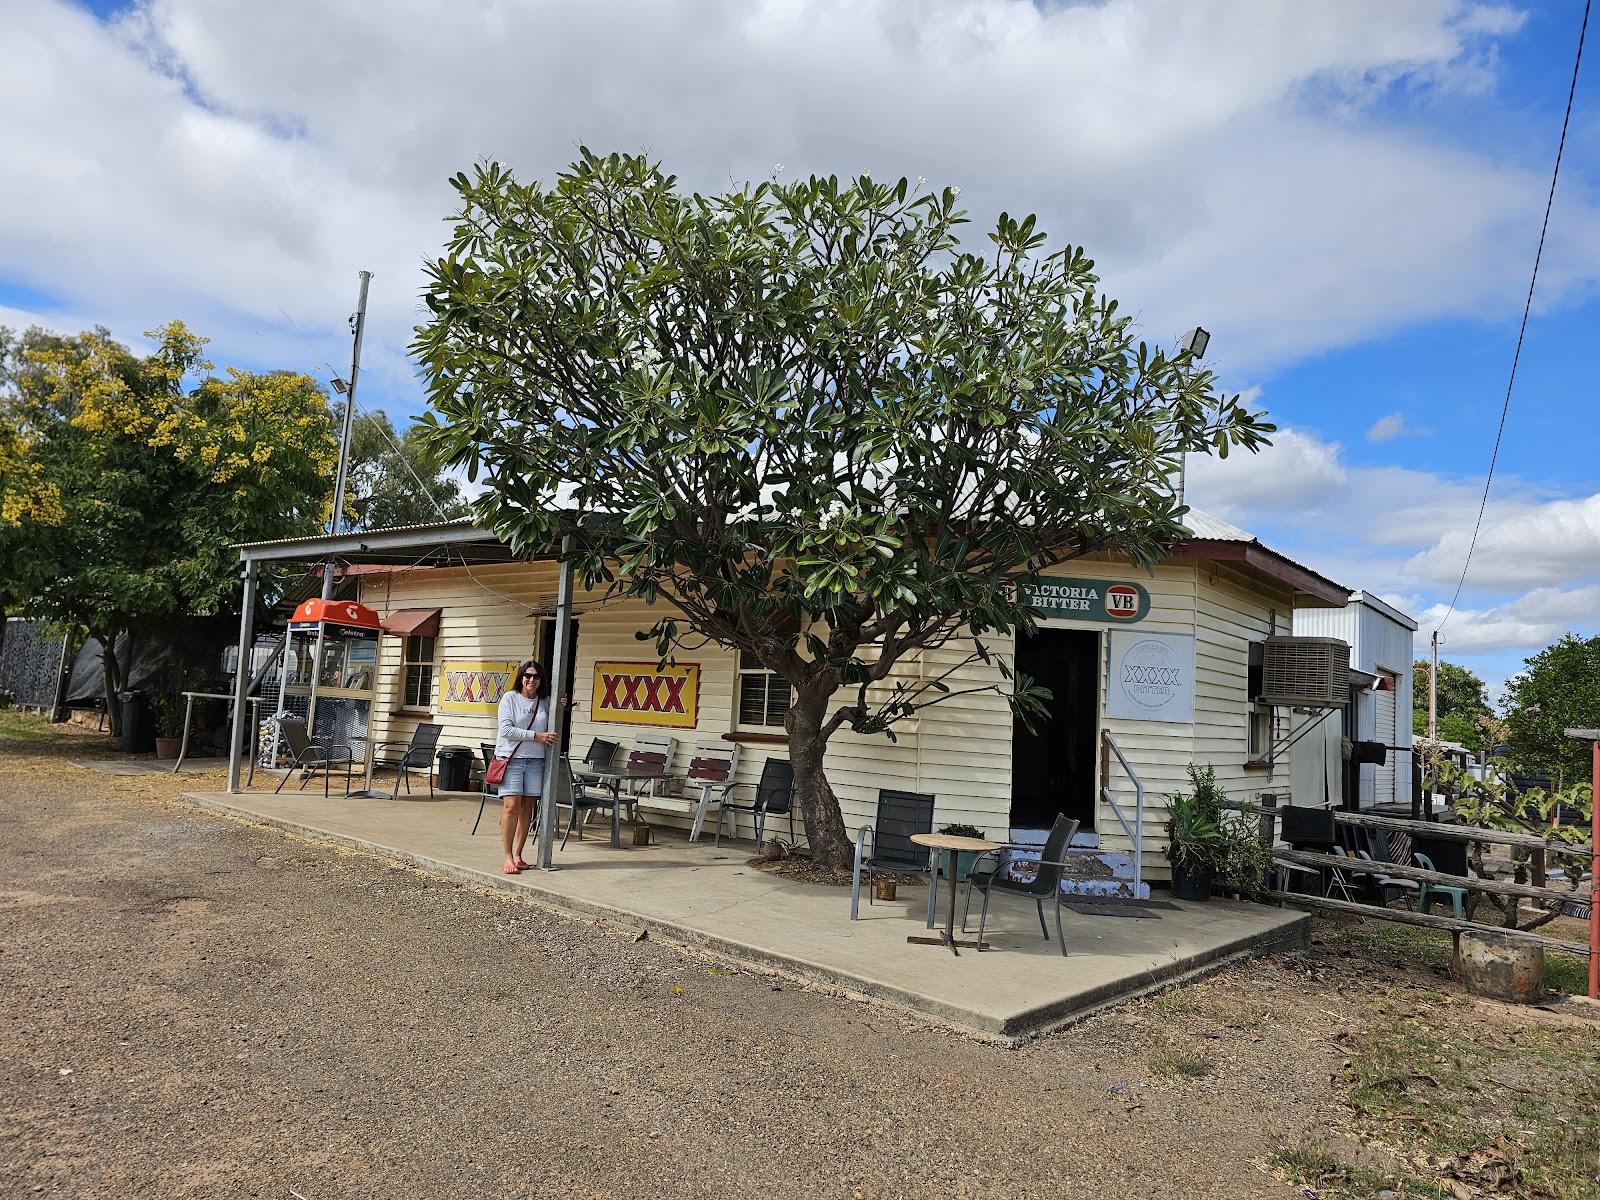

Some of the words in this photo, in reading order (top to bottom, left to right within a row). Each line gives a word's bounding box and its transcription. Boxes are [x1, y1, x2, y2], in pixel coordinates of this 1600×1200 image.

[1031, 596, 1091, 611] BITTER
[1111, 594, 1135, 609] VB
[1124, 664, 1181, 686] XXXX
[445, 671, 511, 704] XXXX
[599, 673, 688, 713] XXXX
[1133, 684, 1170, 696] BITTER
